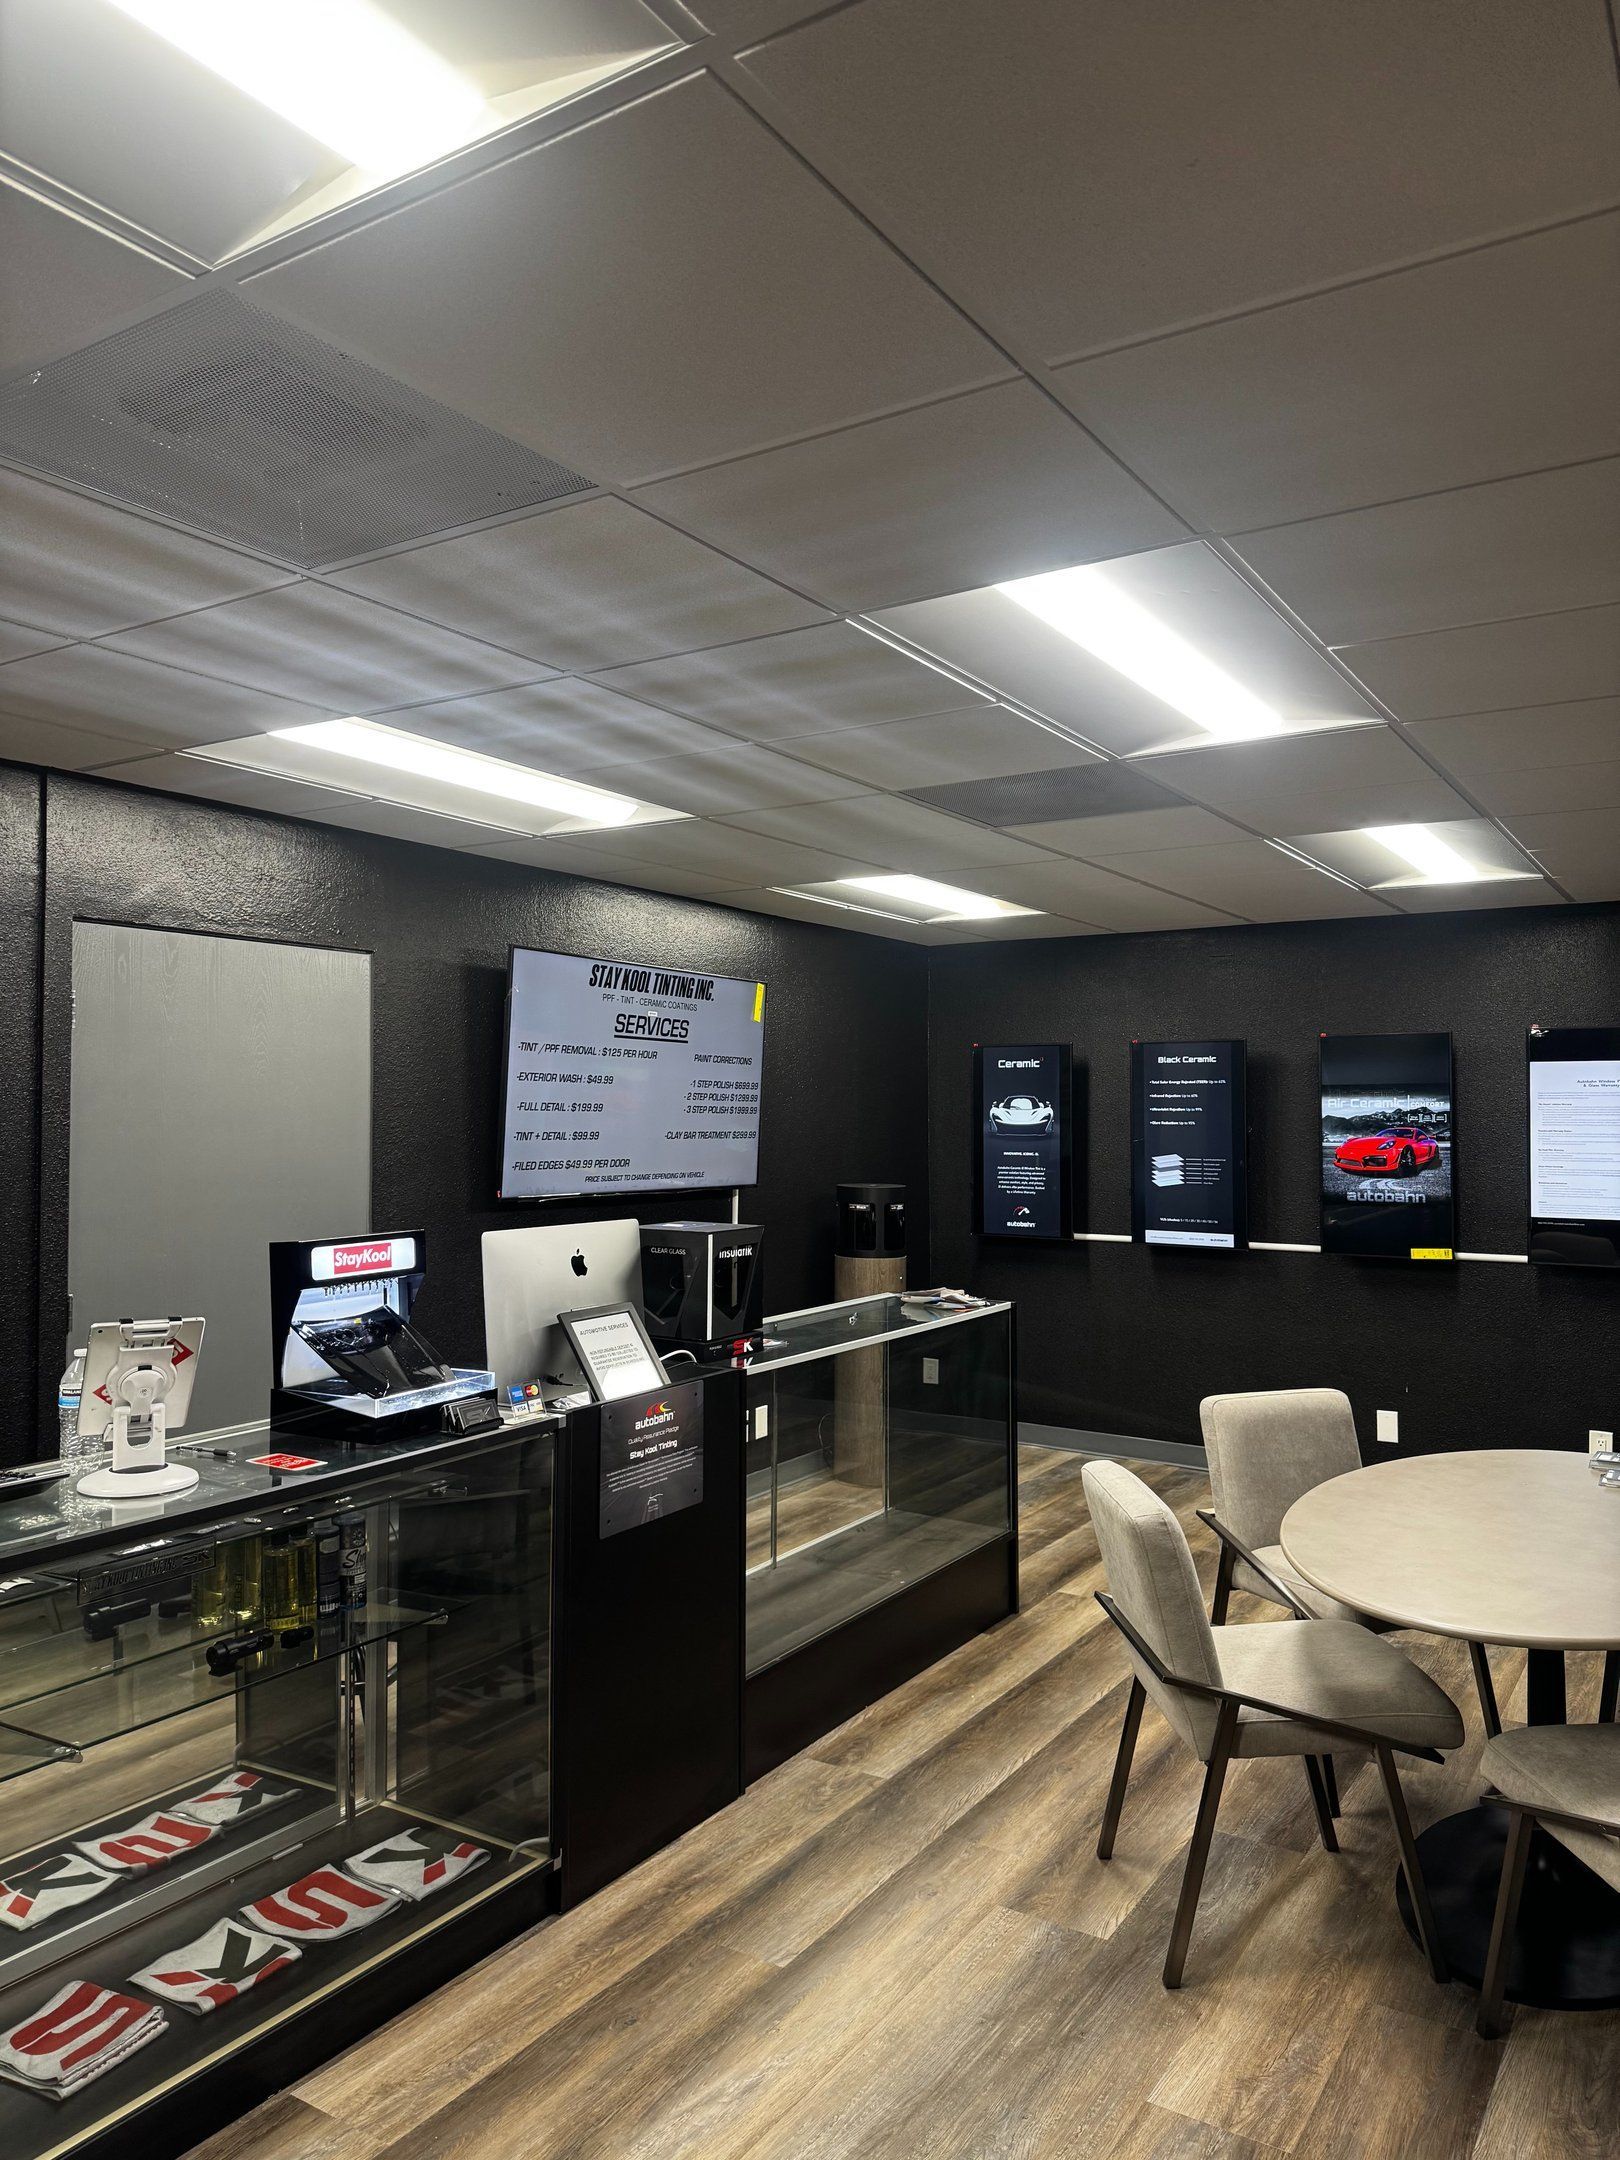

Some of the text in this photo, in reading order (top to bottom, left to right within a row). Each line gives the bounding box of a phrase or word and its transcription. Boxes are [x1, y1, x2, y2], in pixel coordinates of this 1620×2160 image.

[589, 964, 714, 1001] STAY KOOL TINTING INC.
[602, 993, 616, 1002] PPF
[621, 995, 635, 1004] TINT
[639, 998, 667, 1008] CERAMIC
[667, 1000, 698, 1011] COATINGS
[614, 1013, 690, 1038] SERVICES
[601, 1047, 622, 1057] $125
[623, 1049, 637, 1058] PER
[638, 1051, 658, 1060] HOUR
[694, 1054, 753, 1066] PAINT CORRECTIONS
[998, 1058, 1040, 1068] Ceramic
[1157, 1055, 1217, 1064] Black Ceramic
[587, 1075, 614, 1085] $49.99
[697, 1080, 713, 1088] STEP
[713, 1080, 734, 1089] POLISH
[692, 1093, 708, 1101] STEP
[708, 1093, 730, 1102] POLISH
[1328, 1098, 1346, 1108] Air
[1350, 1098, 1405, 1108] Ceramic
[571, 1103, 604, 1113] $199.99
[692, 1105, 708, 1114] STEP
[708, 1106, 730, 1114] POLISH
[572, 1131, 600, 1141] $99.99
[683, 1131, 697, 1140] BAR
[698, 1131, 732, 1139] TREATMENT
[538, 1160, 565, 1170] EDGES
[565, 1160, 593, 1170] $49.99
[594, 1159, 609, 1169] PER
[609, 1158, 631, 1168] DOOR
[584, 1175, 600, 1183] PRICE
[686, 1171, 705, 1179] VEHICLE
[1347, 1189, 1426, 1204] autobahn
[651, 1246, 687, 1256] CLEAR GLASS
[334, 1245, 391, 1269] StayKool
[635, 1411, 674, 1430] autobahn
[630, 1439, 678, 1460] Stay Kool Tinting
